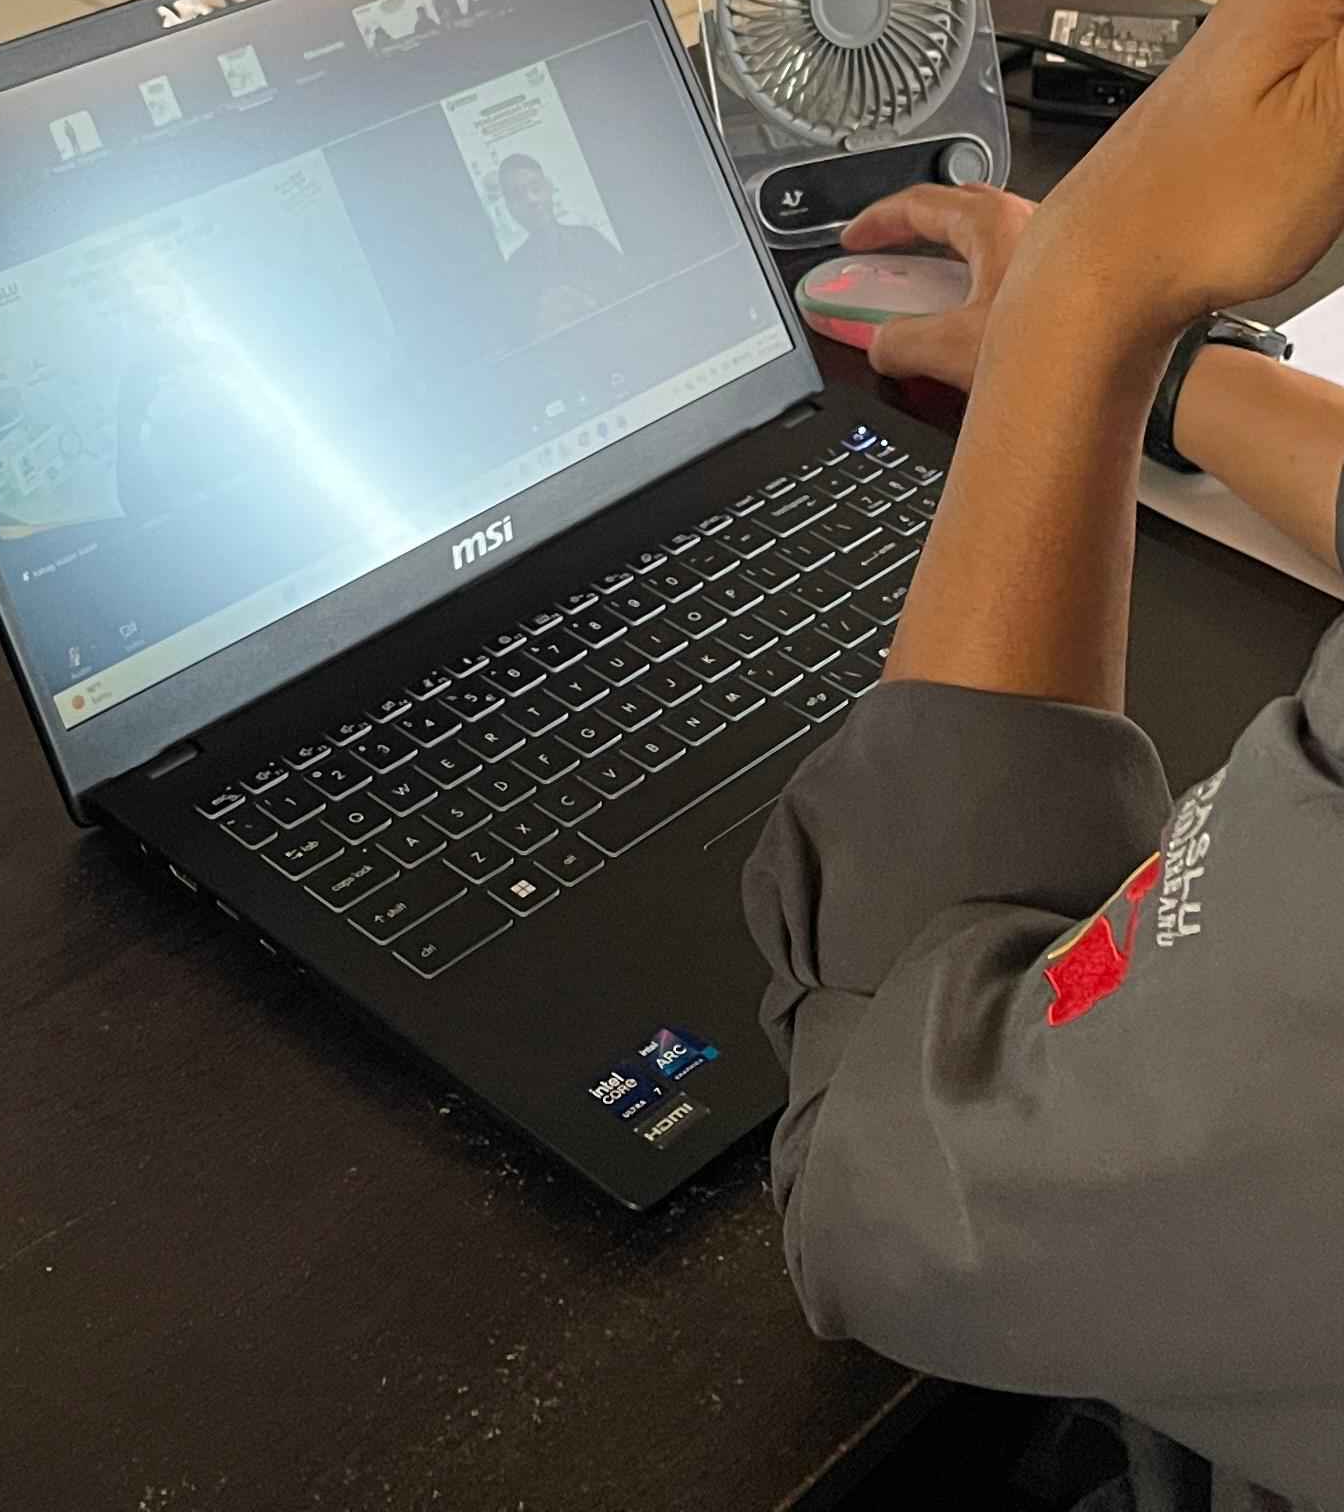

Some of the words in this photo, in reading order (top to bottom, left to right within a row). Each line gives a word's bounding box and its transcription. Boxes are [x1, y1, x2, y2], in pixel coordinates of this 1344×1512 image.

[450, 515, 515, 570] msi
[655, 1043, 689, 1071] ARC
[588, 1071, 625, 1101] intel
[643, 1101, 694, 1142] HDMI
